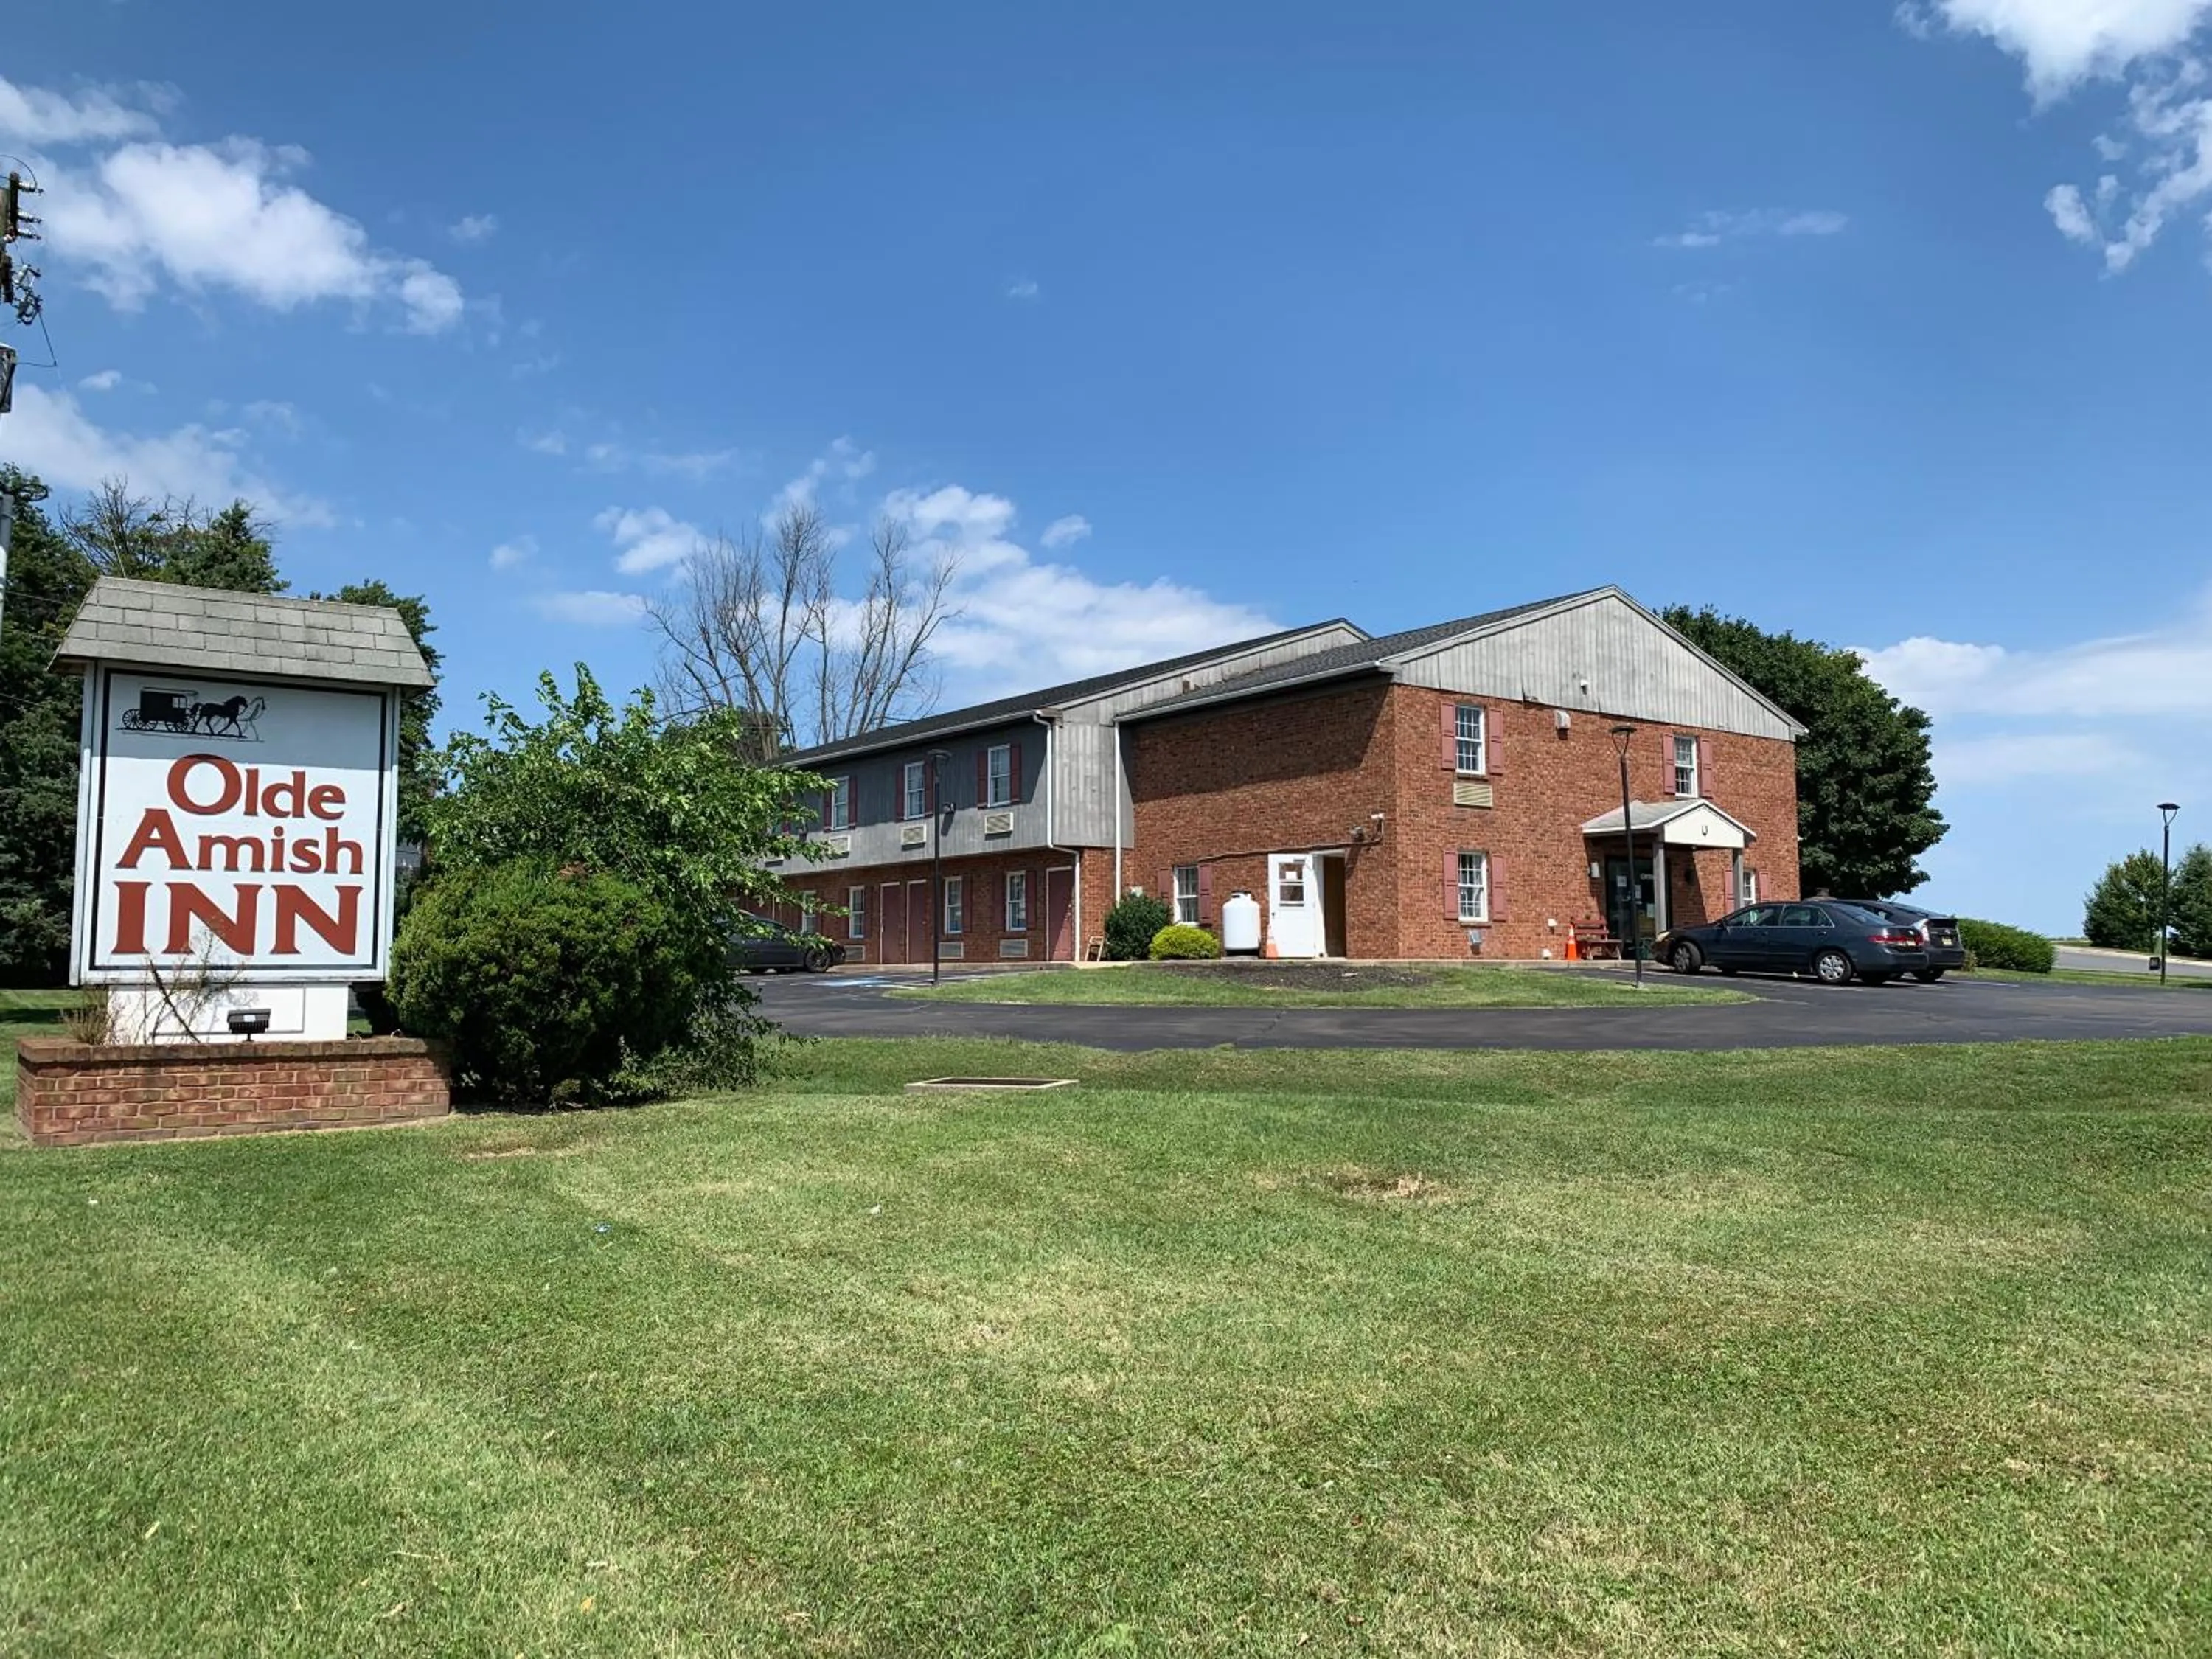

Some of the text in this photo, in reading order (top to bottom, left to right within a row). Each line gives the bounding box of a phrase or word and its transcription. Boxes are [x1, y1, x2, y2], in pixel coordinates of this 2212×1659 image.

[167, 753, 346, 820] Olde
[115, 808, 364, 874] Amish
[111, 881, 364, 956] INN
